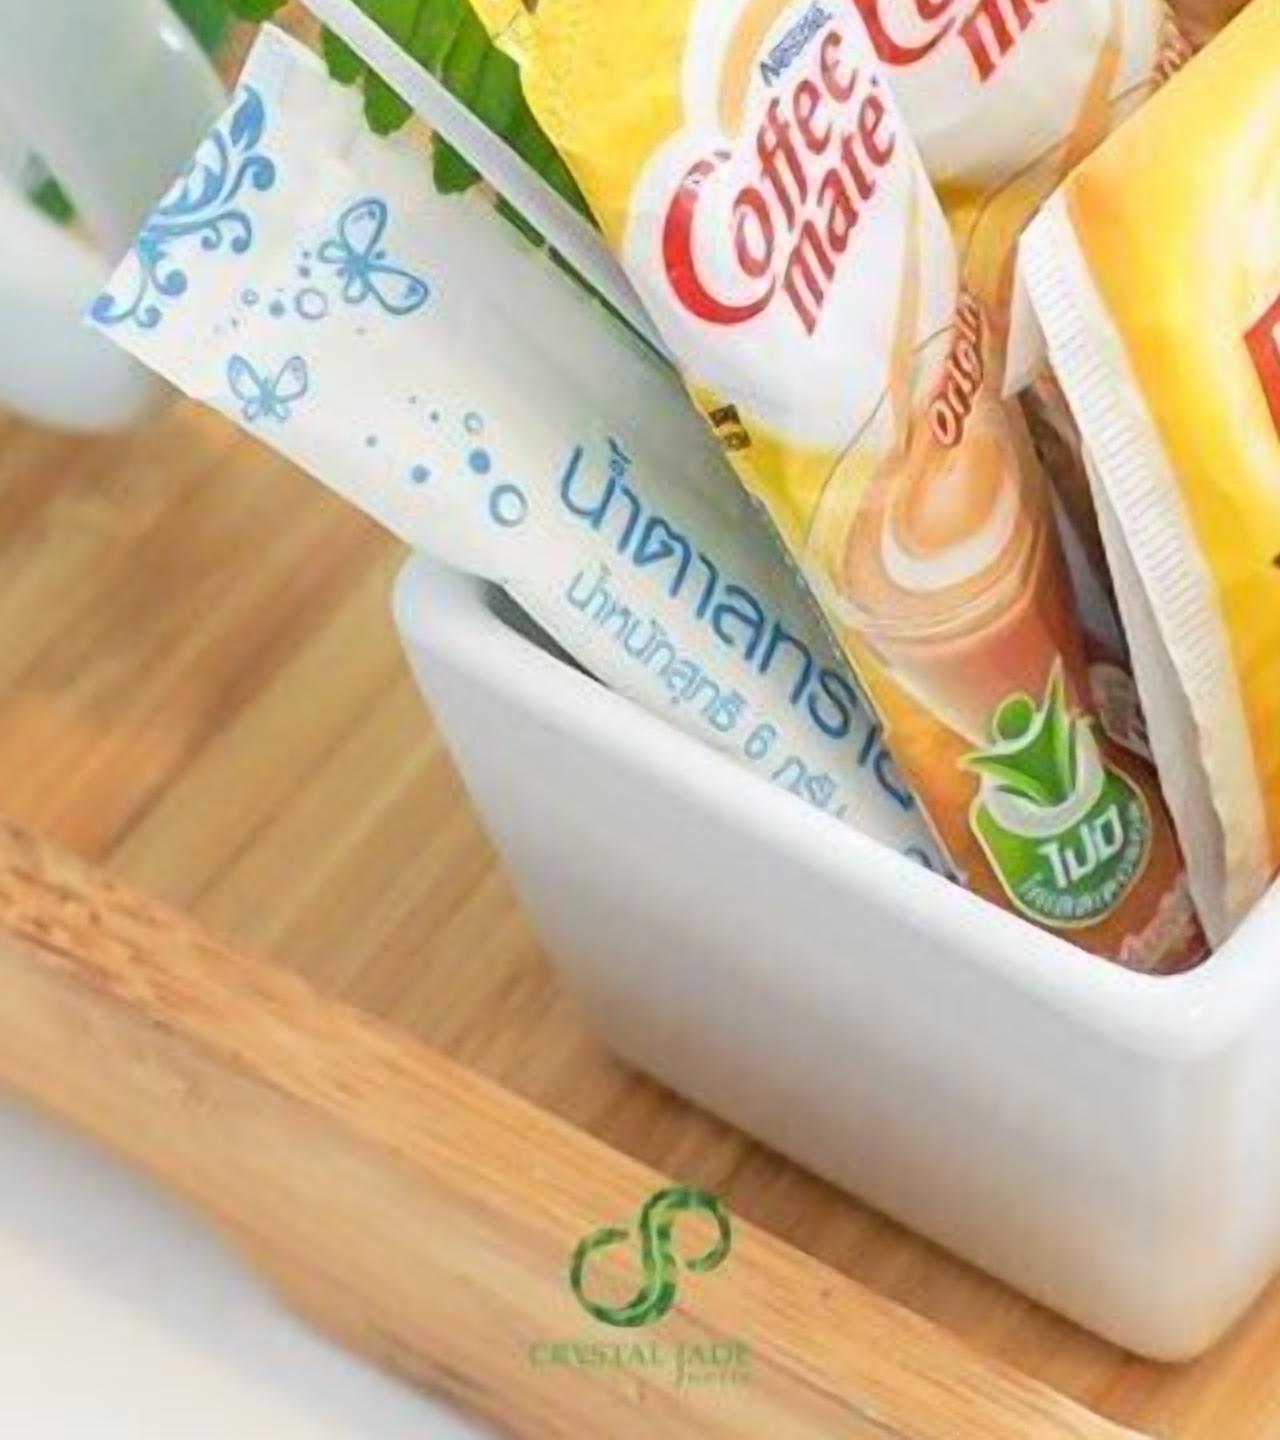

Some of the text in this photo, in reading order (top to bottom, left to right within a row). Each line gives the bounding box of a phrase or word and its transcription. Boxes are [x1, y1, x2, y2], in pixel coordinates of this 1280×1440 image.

[662, 27, 858, 327] Coffee
[782, 94, 896, 338] mate
[744, 722, 777, 761] 6
